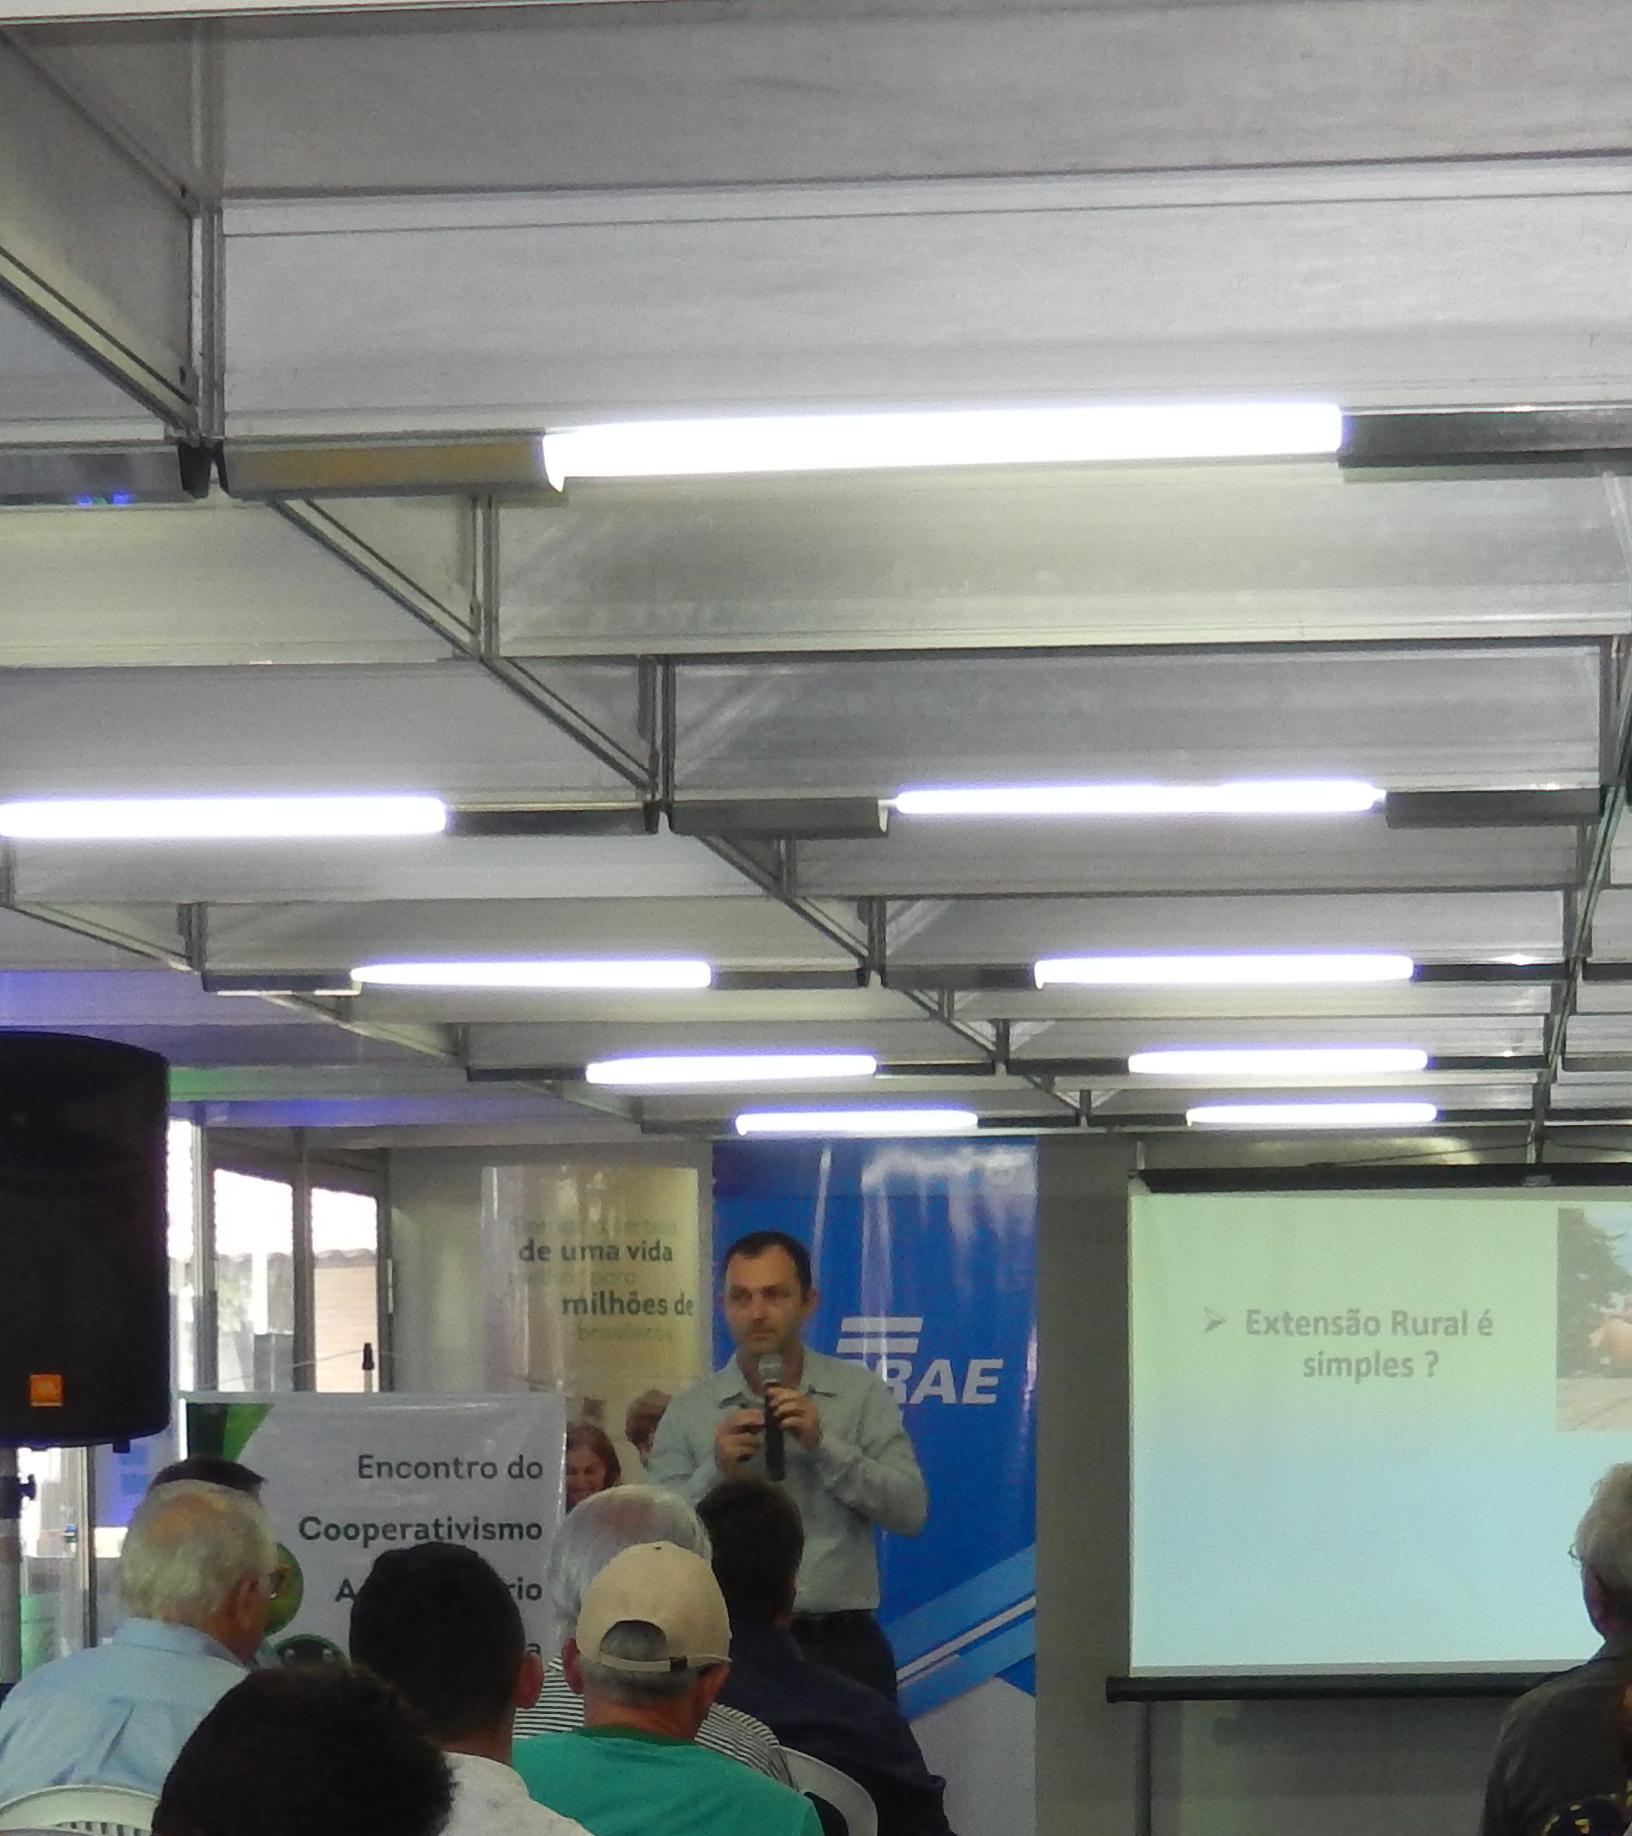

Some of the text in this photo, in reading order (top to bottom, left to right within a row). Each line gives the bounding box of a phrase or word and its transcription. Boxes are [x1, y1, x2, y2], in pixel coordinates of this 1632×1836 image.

[518, 1239, 673, 1262] de uma vida
[562, 1290, 695, 1316] milhões de
[1245, 1308, 1494, 1337] Extensão Rural é
[1303, 1350, 1439, 1385] simples ?
[358, 1454, 543, 1480] Encontro do
[299, 1516, 543, 1548] Cooperativismo
